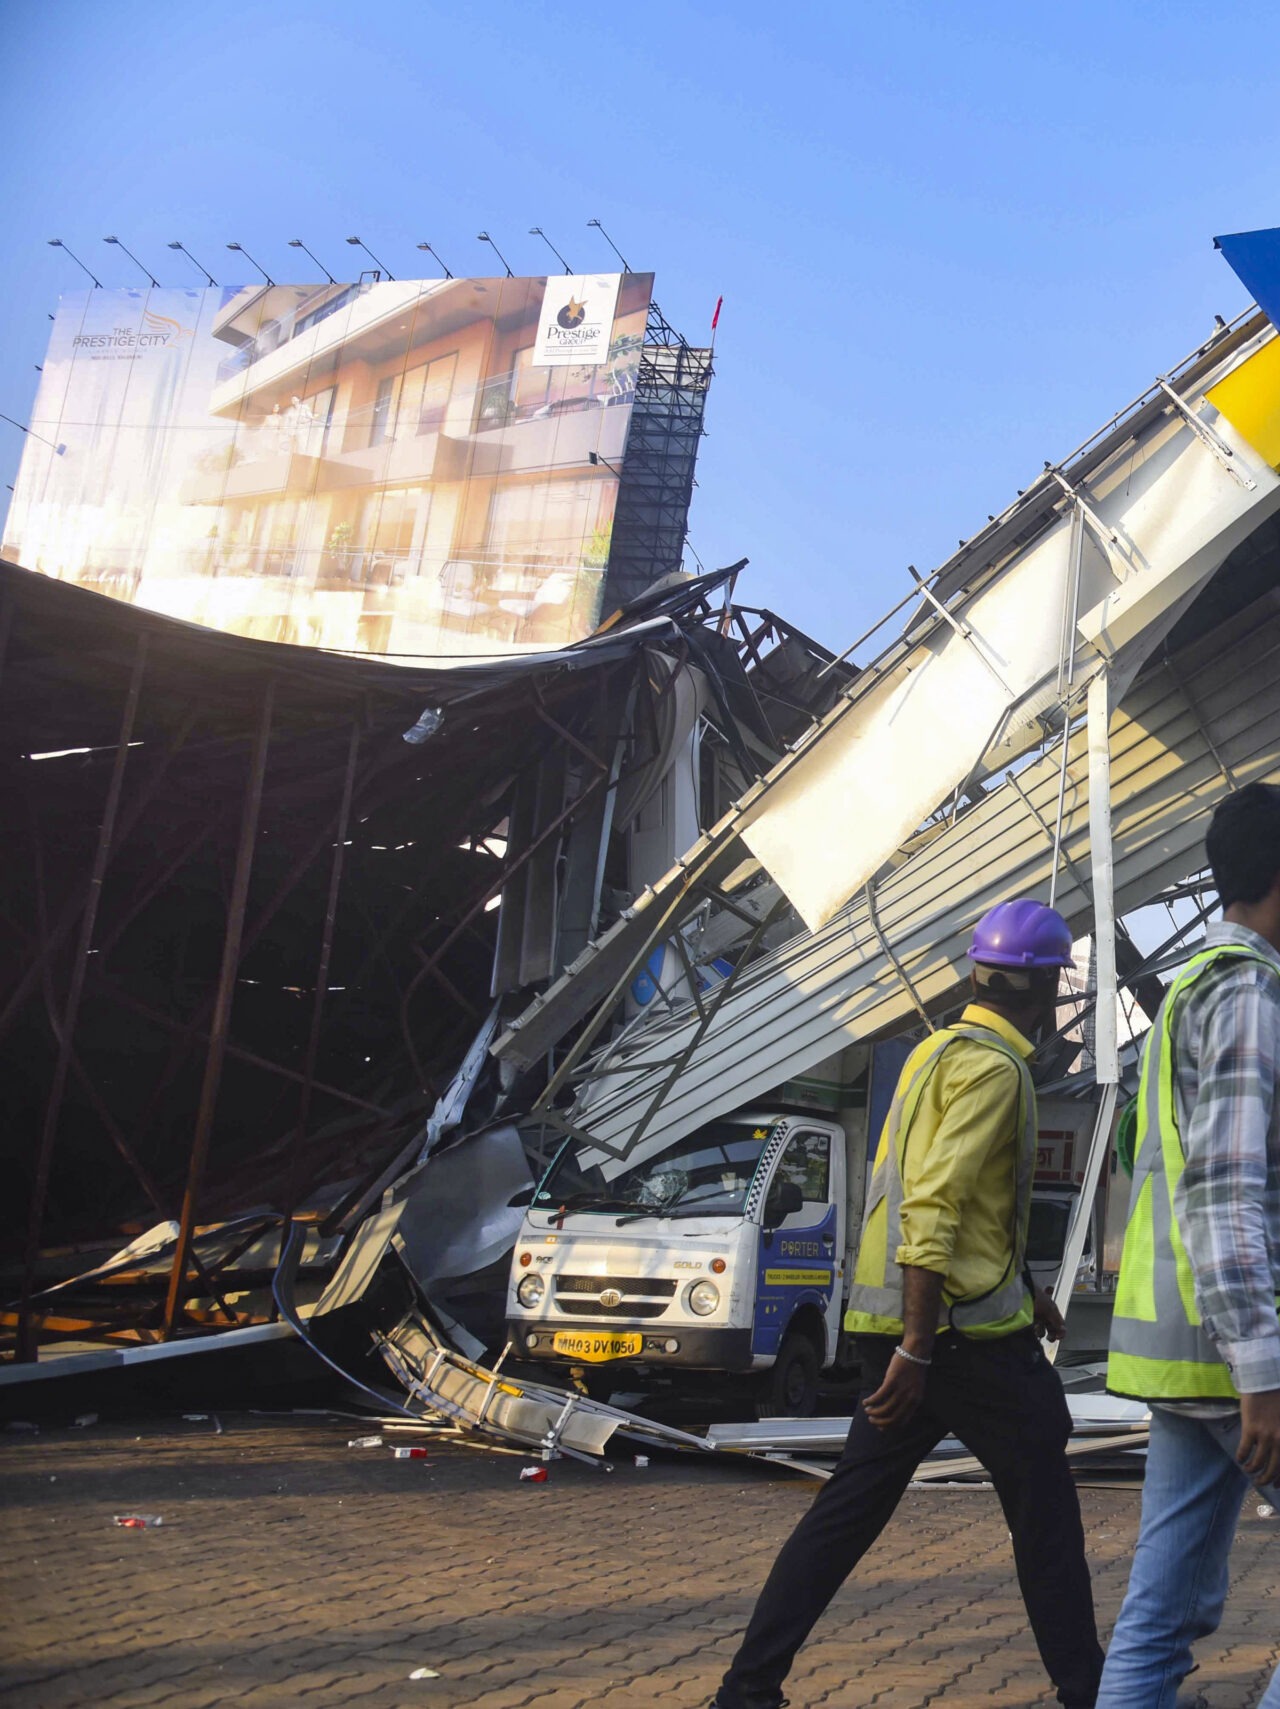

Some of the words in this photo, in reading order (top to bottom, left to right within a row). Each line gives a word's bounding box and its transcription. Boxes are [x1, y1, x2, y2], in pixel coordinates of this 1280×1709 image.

[113, 327, 133, 336] THE
[547, 326, 601, 340] Prestige
[72, 335, 136, 348] PRESTIGE
[139, 335, 170, 346] CITY
[781, 1240, 819, 1256] PORTER
[673, 1260, 703, 1270] GOLD
